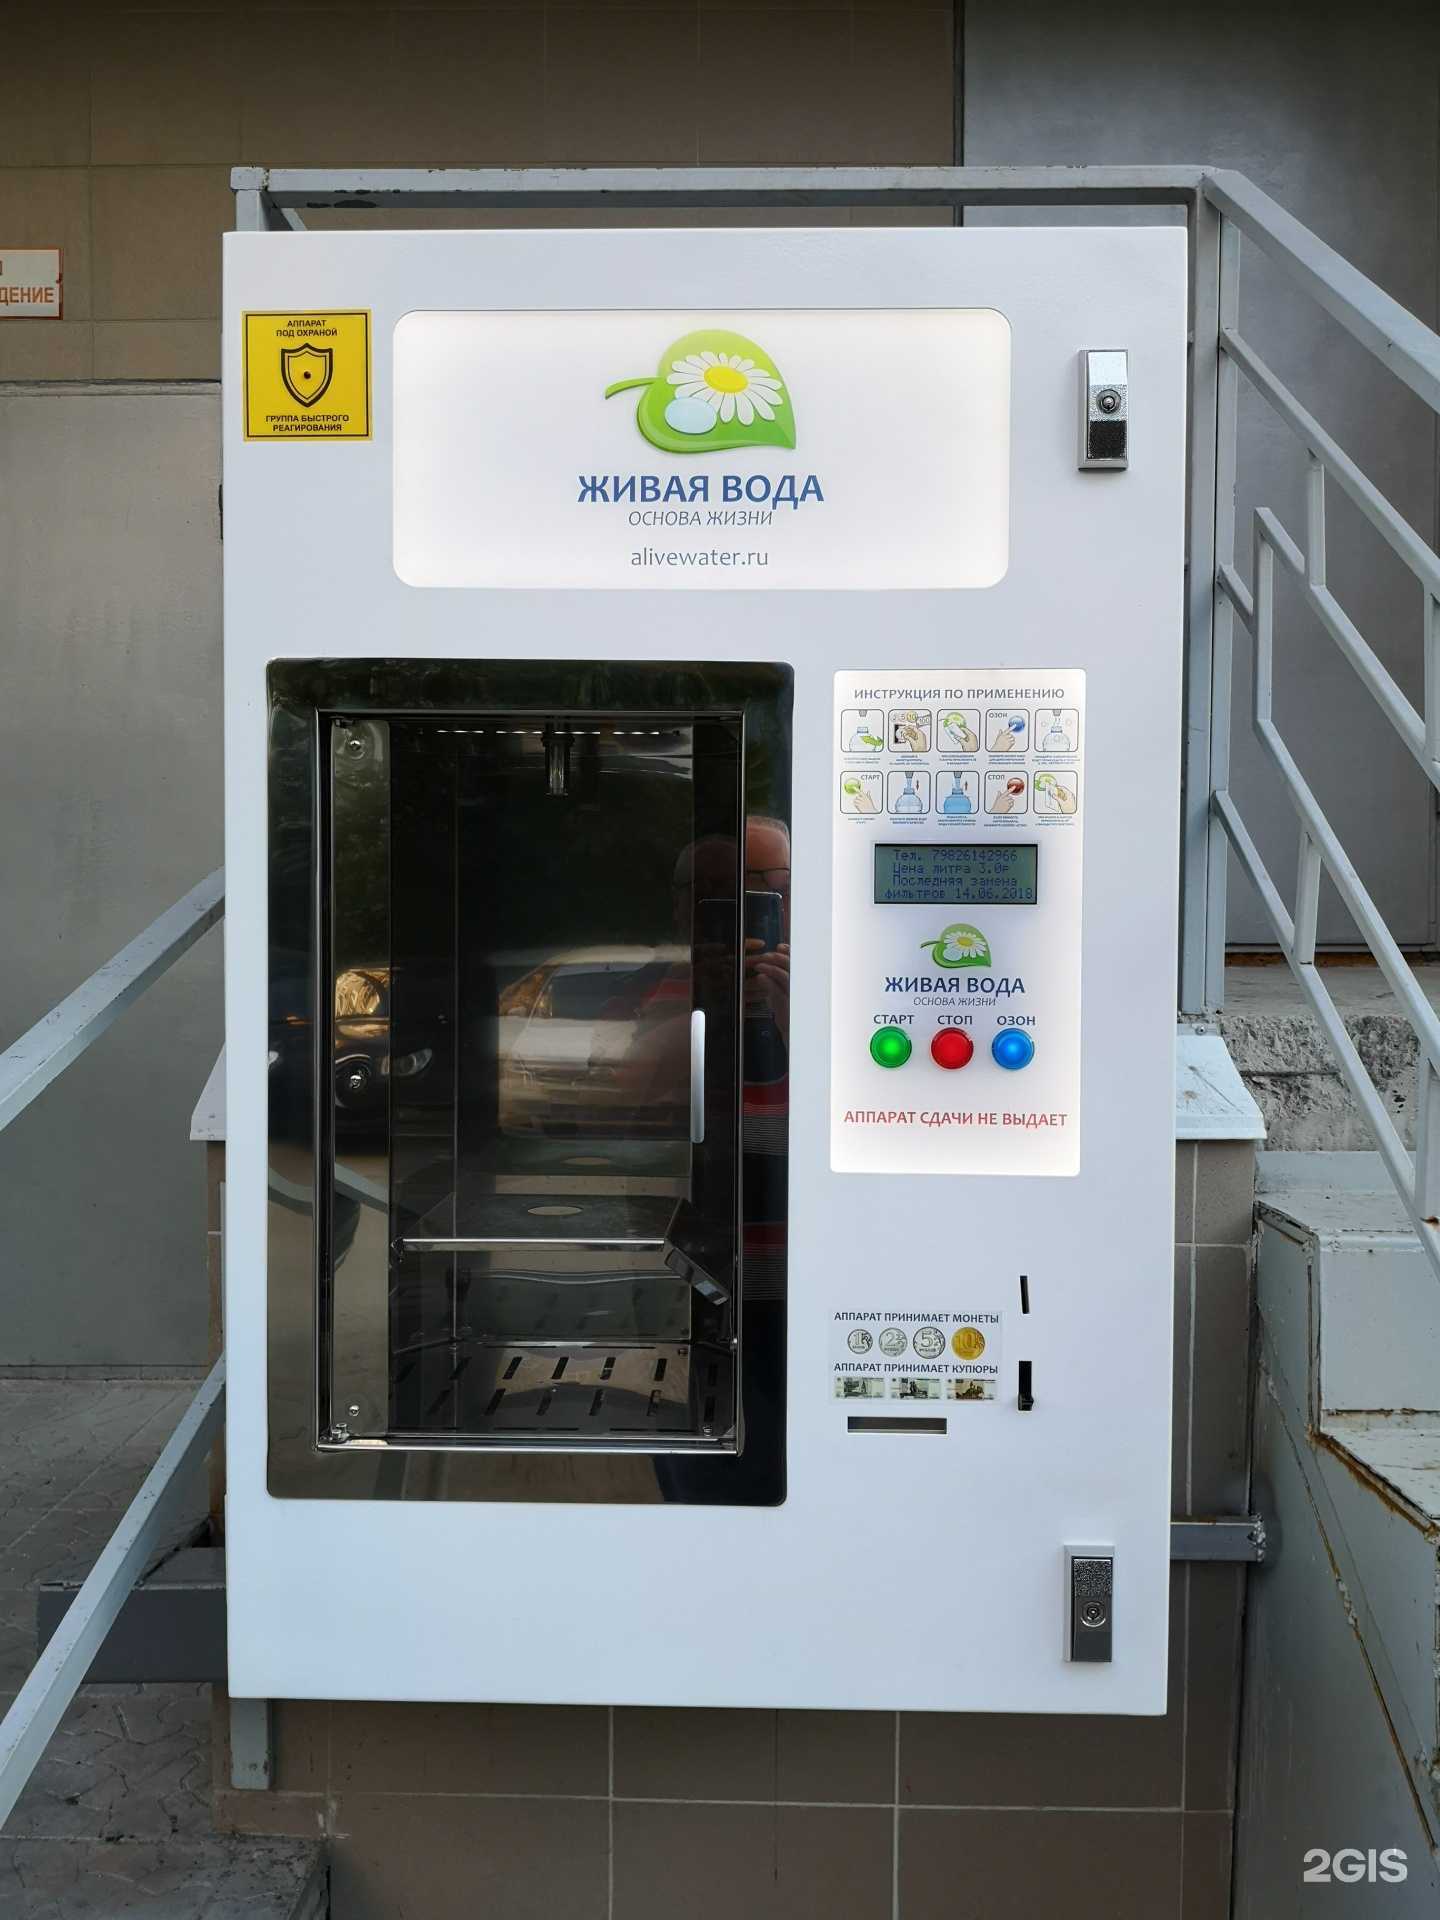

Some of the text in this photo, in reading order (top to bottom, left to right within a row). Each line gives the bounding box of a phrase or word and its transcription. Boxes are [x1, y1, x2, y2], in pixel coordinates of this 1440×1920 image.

[287, 319, 327, 328] АППАРАТ
[276, 327, 338, 338] ПОД ОХРАНОЙ
[265, 414, 349, 423] ГРУППА БЫСТРОГО
[273, 423, 342, 432] РЕАГИРОВАНИЯ
[577, 474, 825, 510] ЖИВАЯ ВОДА
[628, 510, 774, 527] ОСНОВА ЖИЗНИ
[631, 547, 768, 567] alivewater.ru
[854, 688, 1065, 702] ИНСТРУКЦИЯ ПО ПРИМЕНЕНИЮ
[893, 849, 921, 861] Тел.
[893, 863, 925, 875] Цена
[933, 864, 971, 874] литра
[893, 875, 1018, 887] Последняя замена
[884, 888, 945, 899] фильтров
[885, 976, 1026, 997] ЖИВАЯ ВОДА
[913, 996, 998, 1007] ОСНОВА ЖИЗНИ
[873, 1014, 915, 1026] СТАРТ
[937, 1014, 973, 1026] СТОП
[996, 1015, 1037, 1026] ОЗОН
[844, 1111, 1068, 1129] АППАРАТ СДАЧИ НЕ ВЫДАЕТ
[834, 1312, 999, 1324] АППАРАТ ПРИНИМАЕТ МОНЕТЫ
[886, 1331, 896, 1347] 2
[921, 1330, 934, 1348] 5
[955, 1331, 977, 1350] 10
[834, 1362, 998, 1374] АППАРАТ ПРИНИМАЕТ КУПЮРЫ
